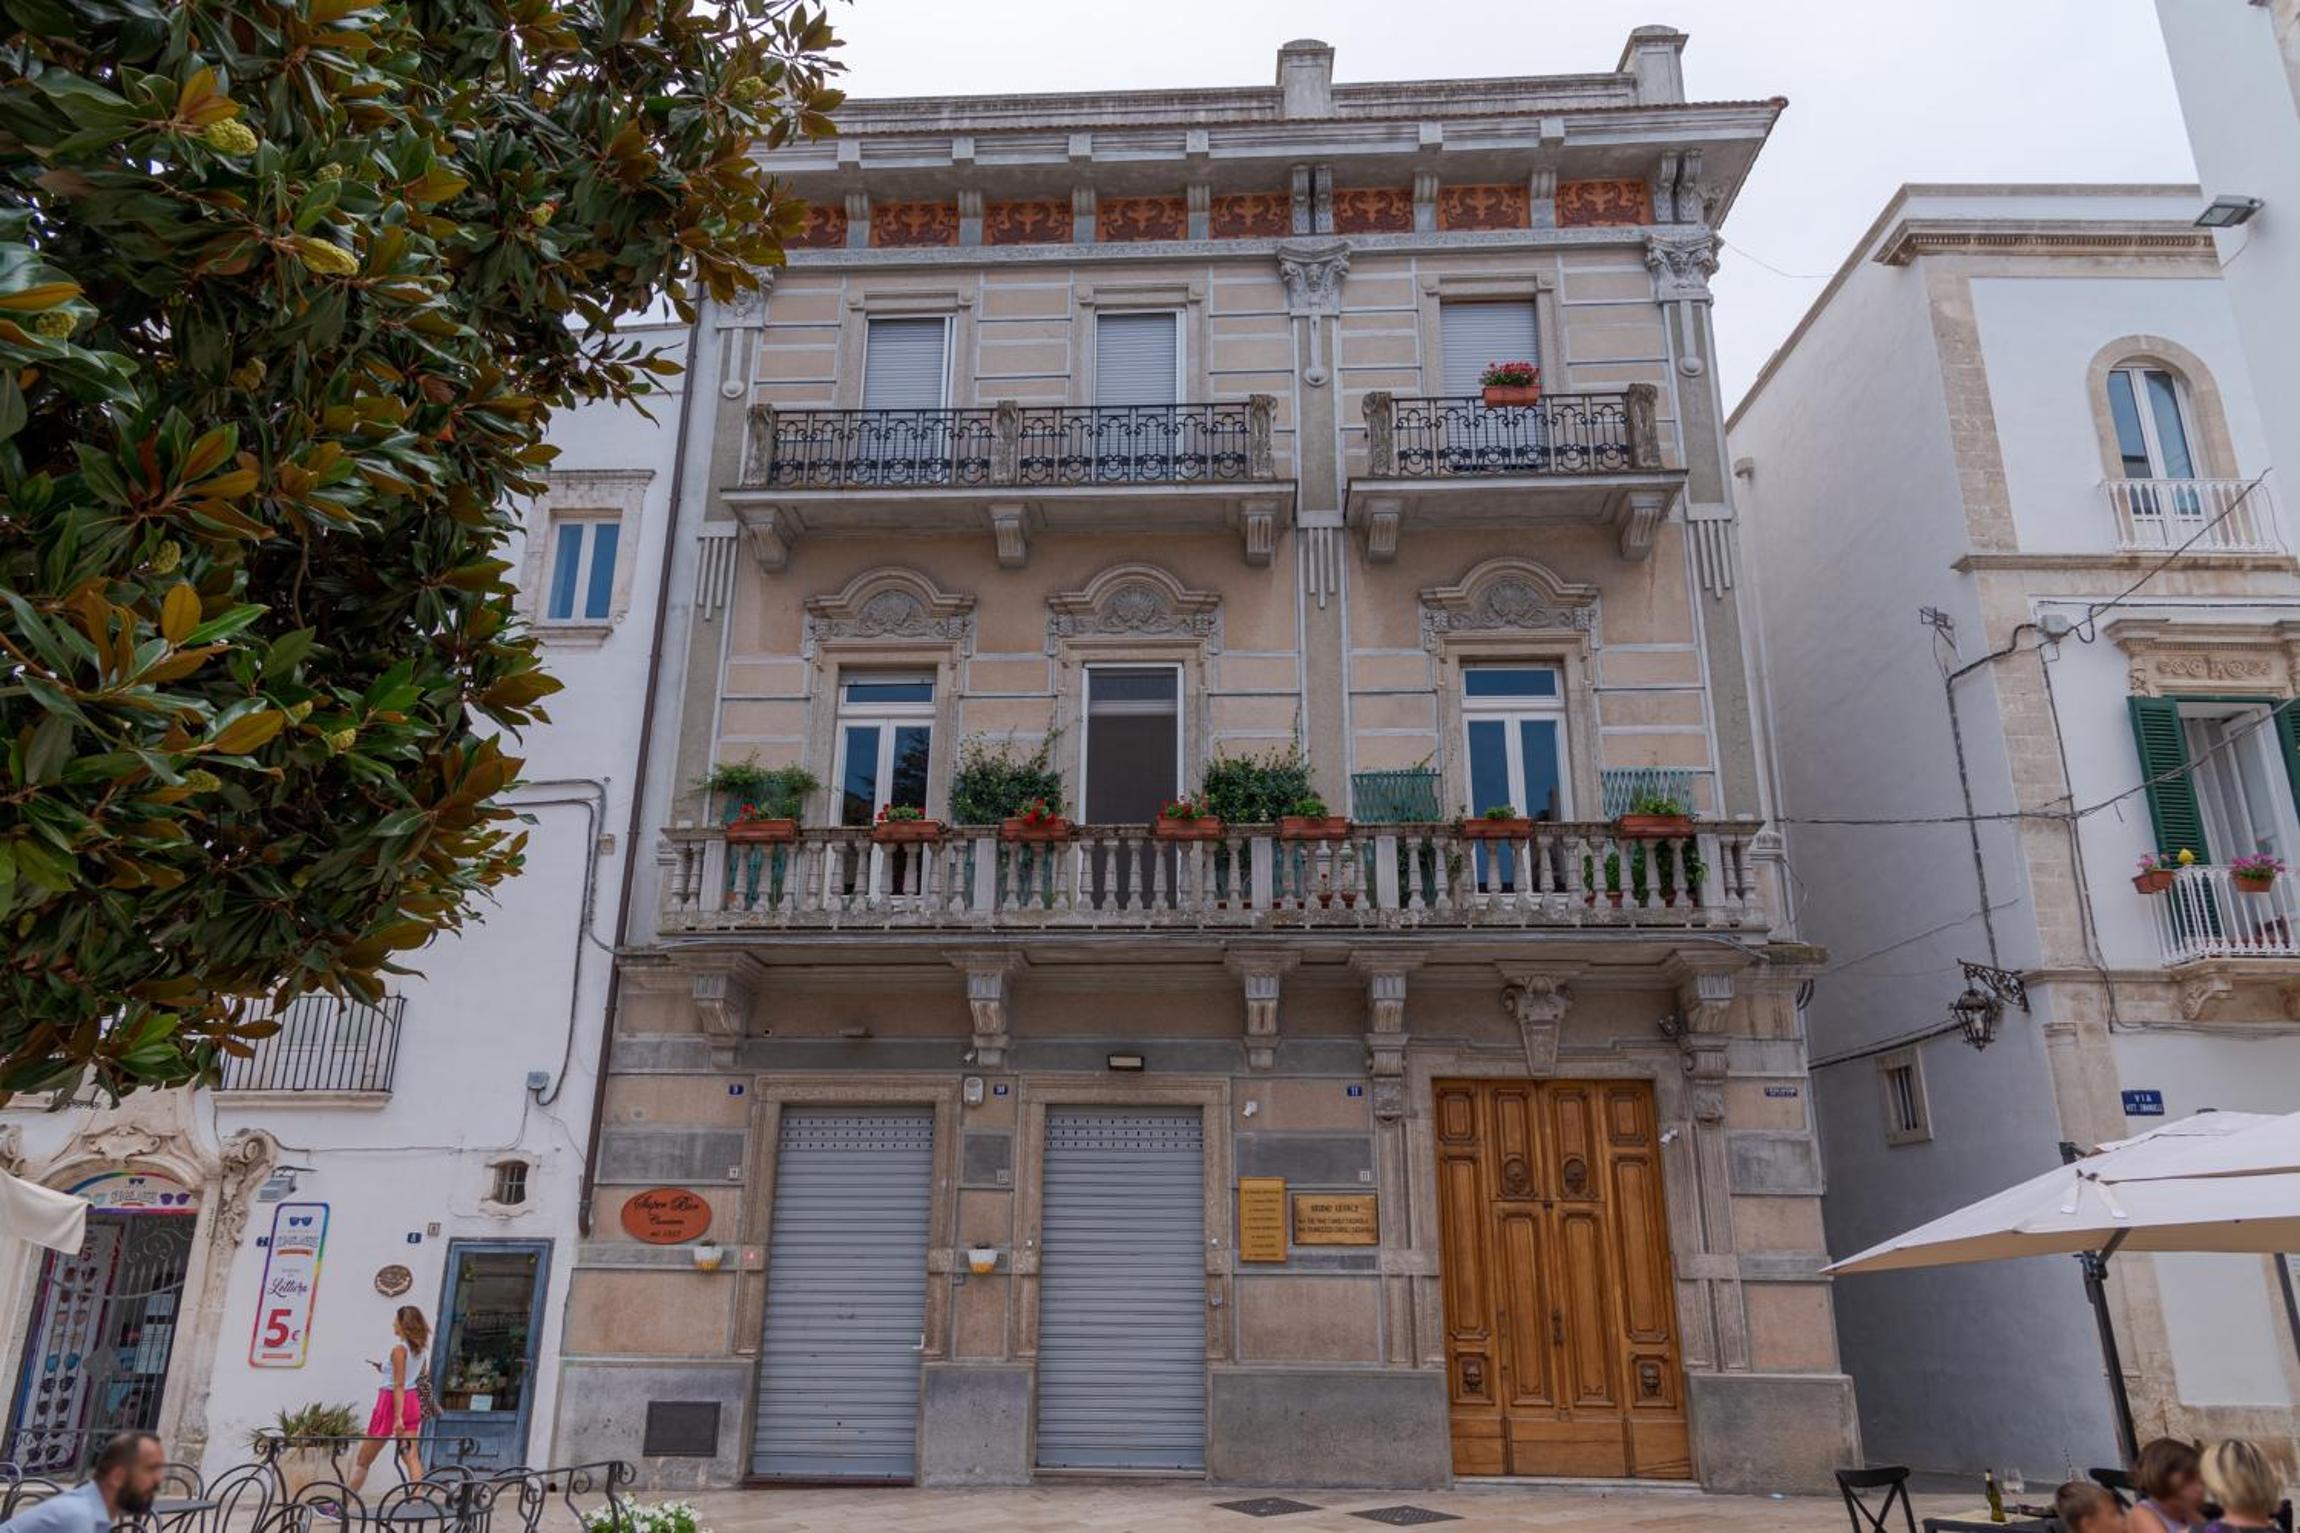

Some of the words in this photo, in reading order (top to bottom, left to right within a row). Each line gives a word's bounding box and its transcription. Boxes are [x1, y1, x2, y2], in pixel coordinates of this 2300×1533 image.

[2134, 1094, 2152, 1102] VIA
[634, 1195, 667, 1214] Super
[267, 1278, 308, 1298] Lettura
